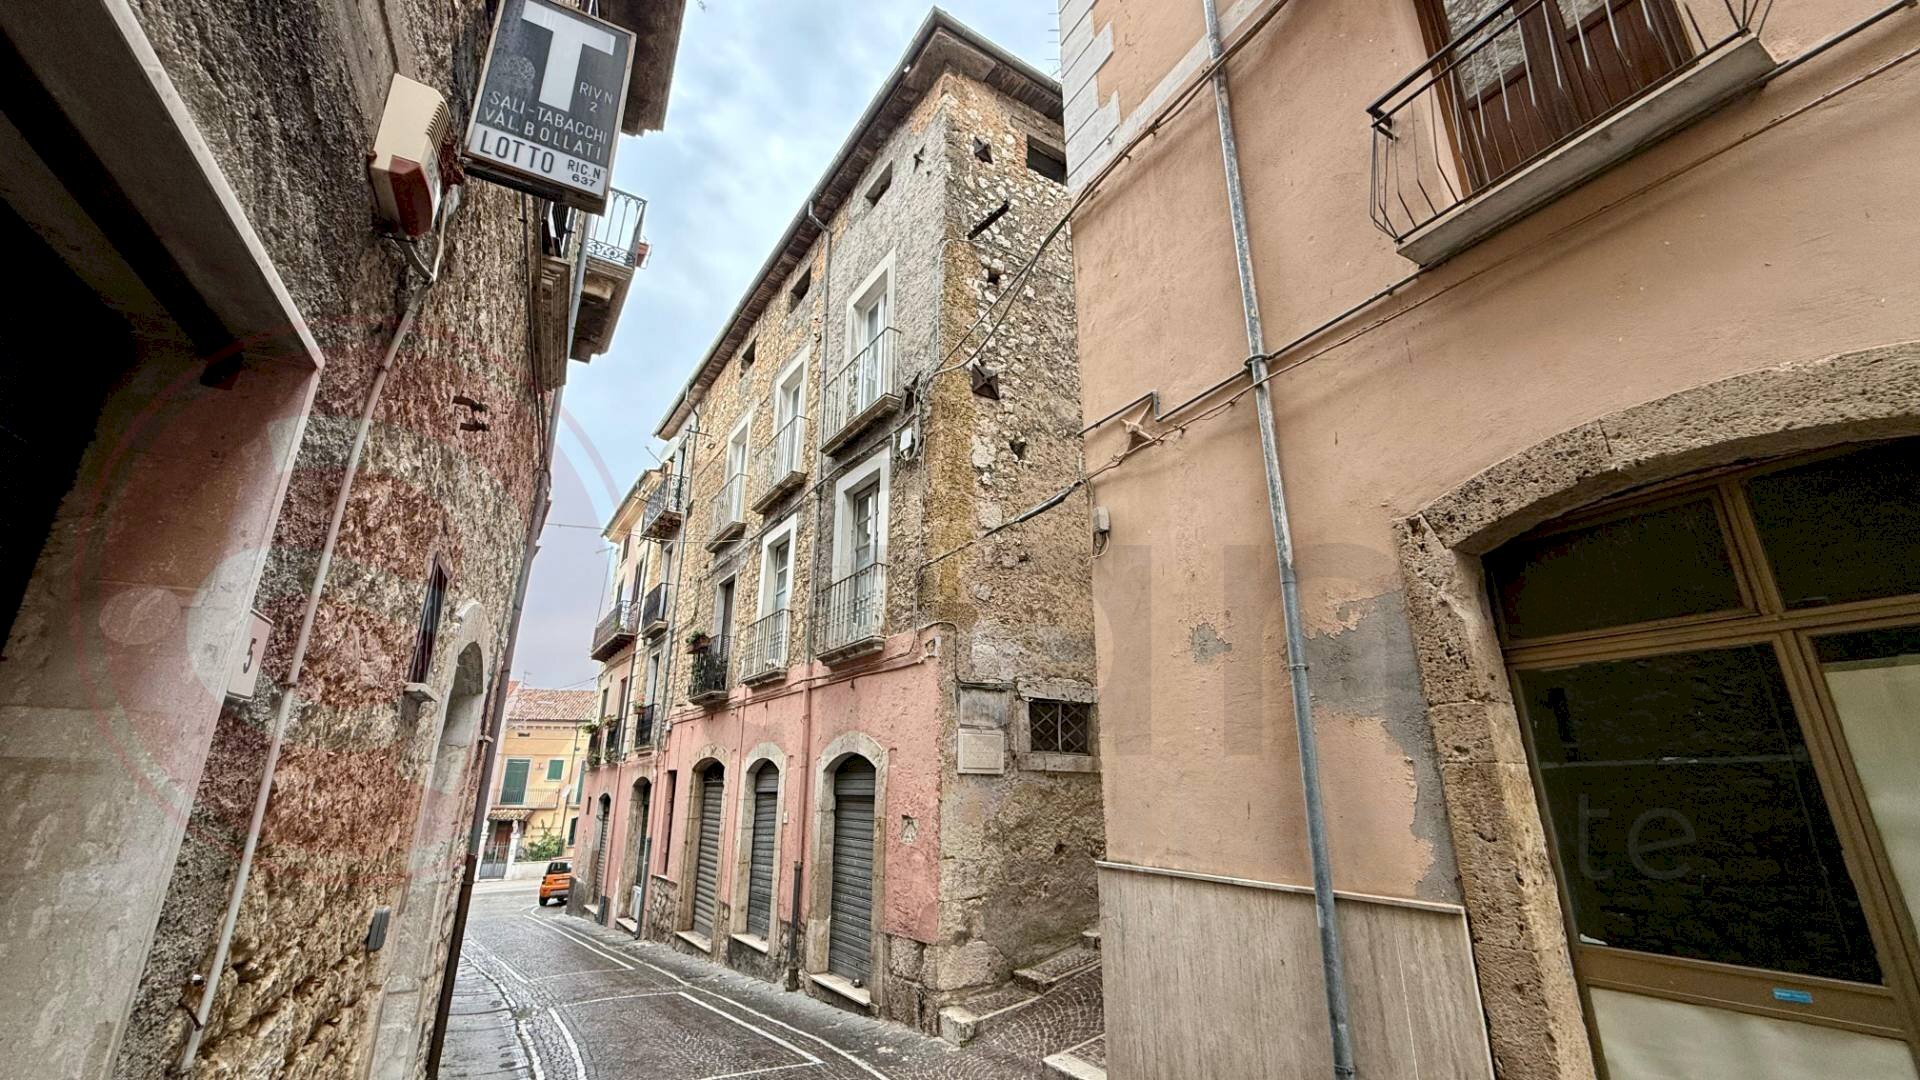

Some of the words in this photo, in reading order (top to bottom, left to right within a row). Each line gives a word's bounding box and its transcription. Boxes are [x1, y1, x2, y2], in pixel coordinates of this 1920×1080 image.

[521, 0, 616, 112] T
[485, 107, 519, 132] VAL.
[589, 101, 598, 113] 2
[480, 130, 555, 174] LOTTO
[524, 121, 601, 159] BOLLATI
[572, 173, 597, 187] 637
[243, 637, 257, 674] 5
